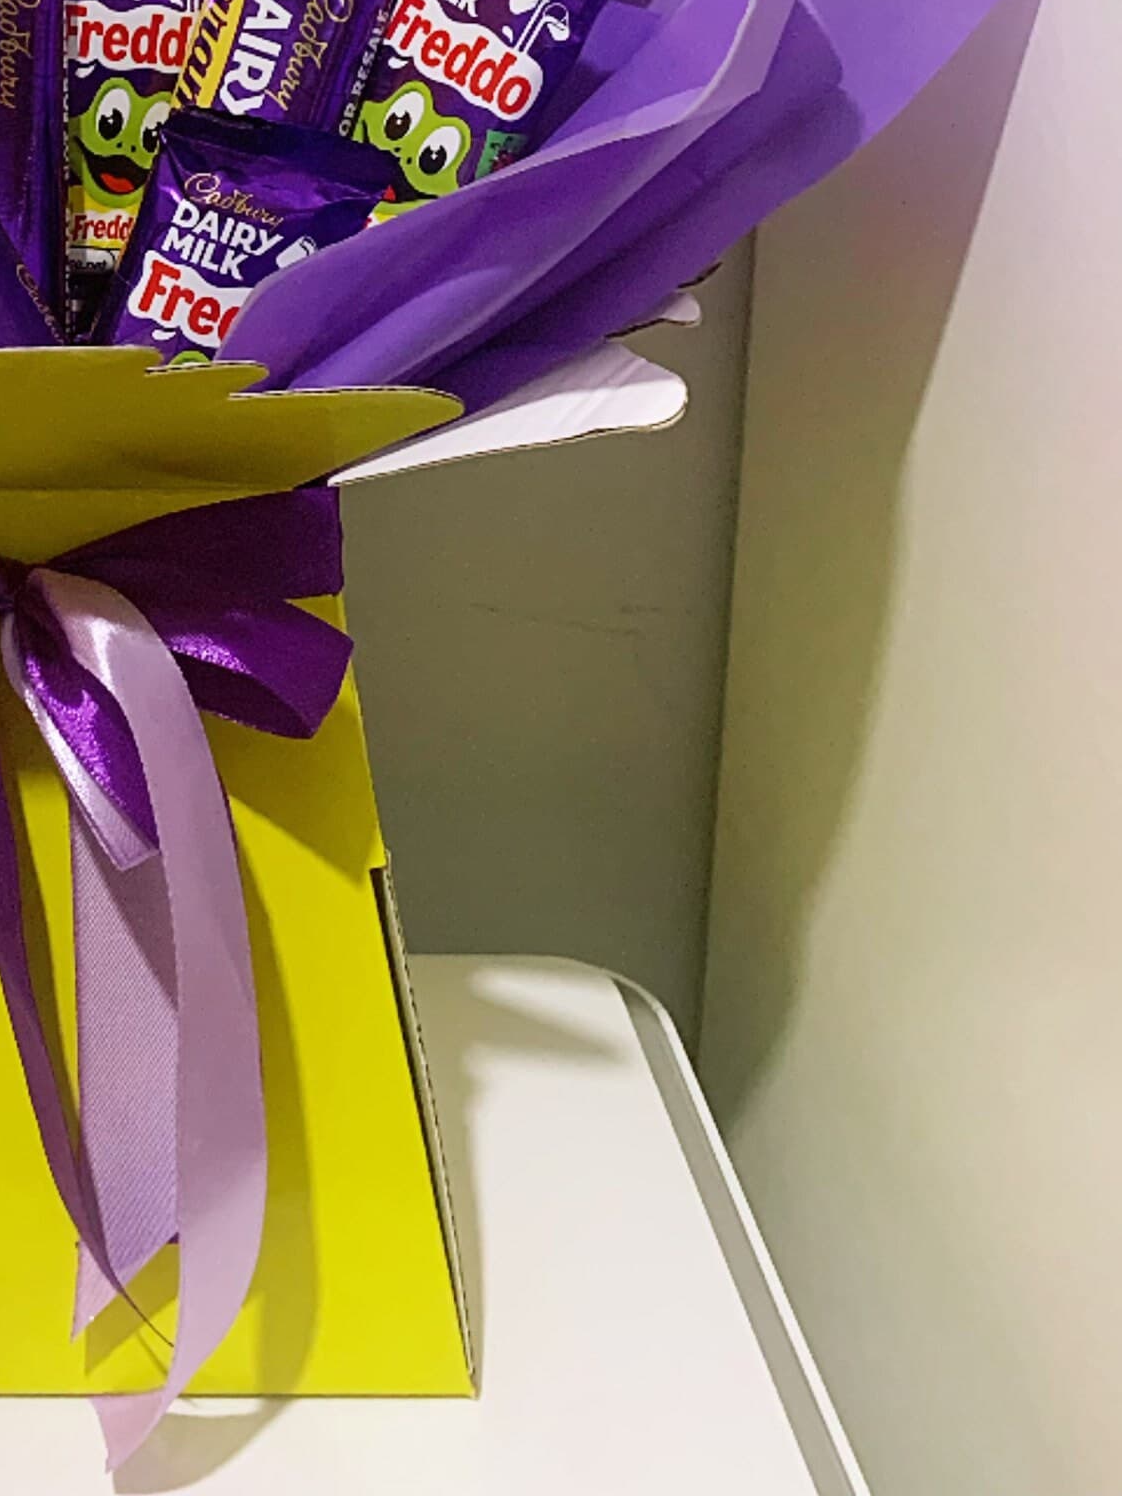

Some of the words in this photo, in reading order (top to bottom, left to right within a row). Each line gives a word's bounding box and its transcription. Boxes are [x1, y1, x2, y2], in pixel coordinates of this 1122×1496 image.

[348, 7, 391, 97] RESALE
[172, 199, 284, 255] DAIRY
[183, 172, 285, 228] Cadbury
[161, 225, 251, 281] MILK
